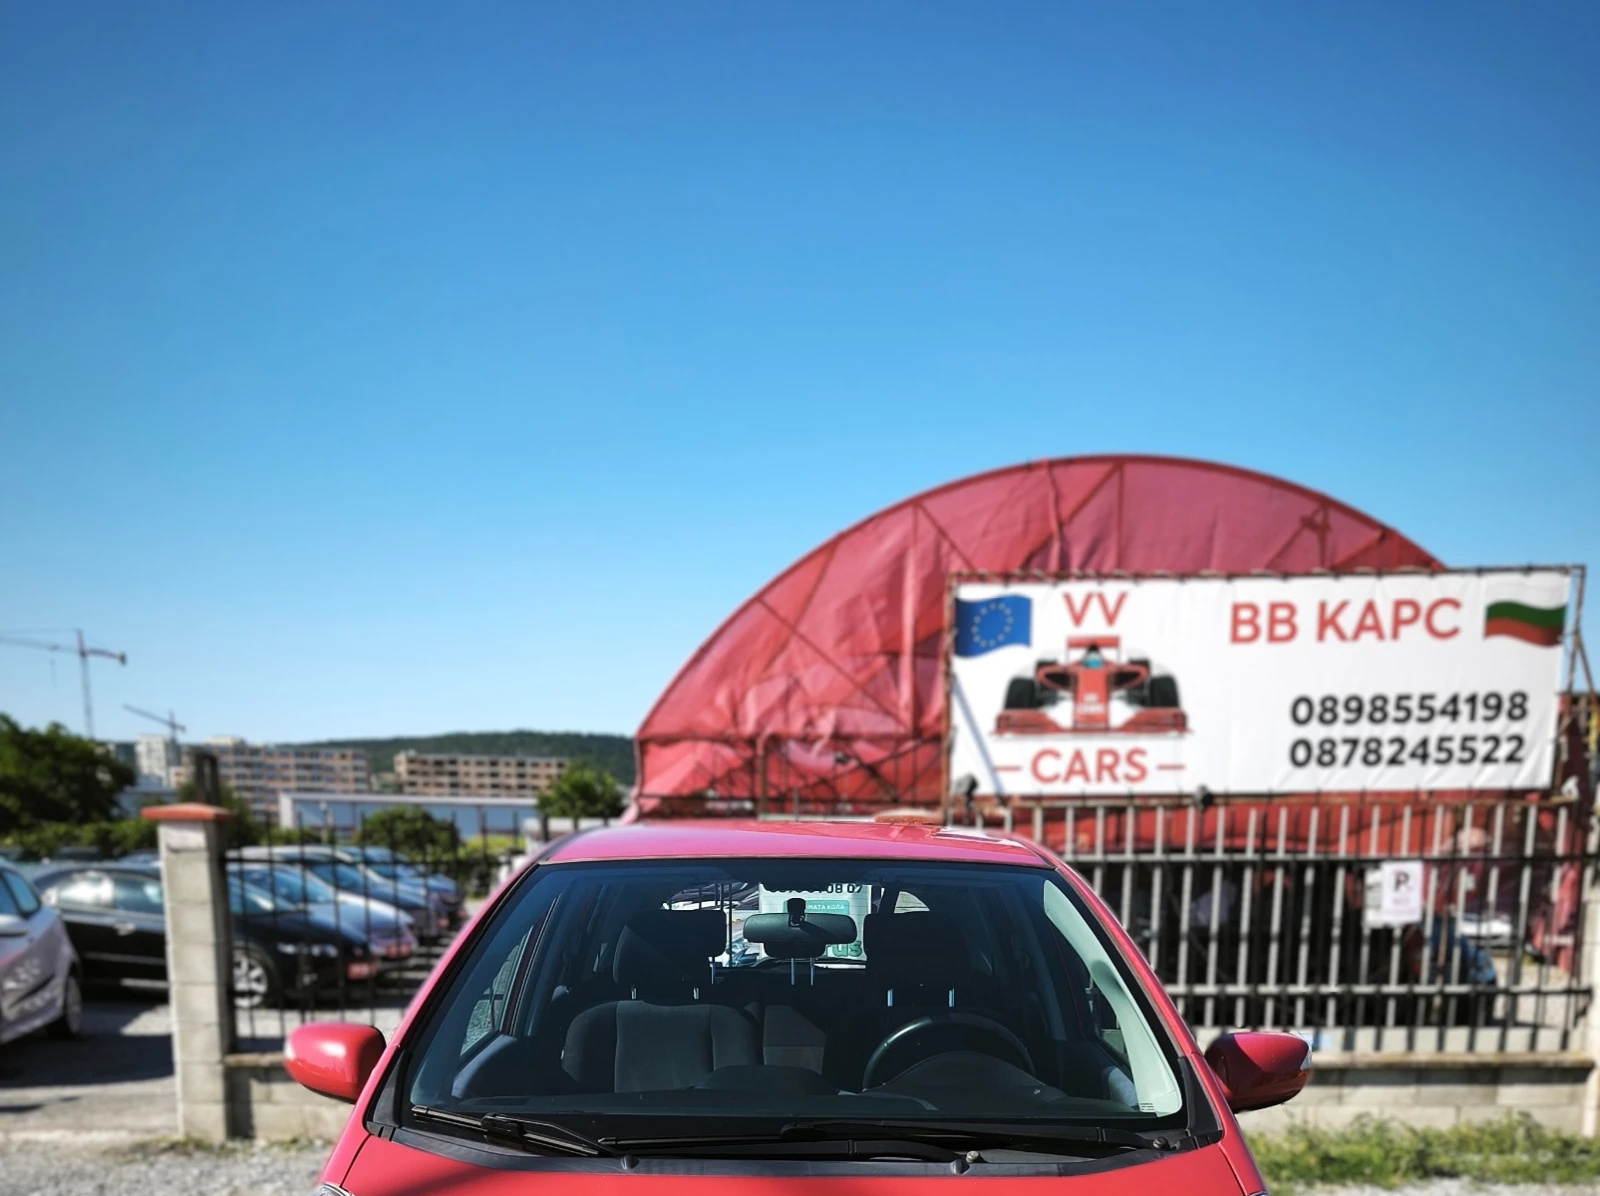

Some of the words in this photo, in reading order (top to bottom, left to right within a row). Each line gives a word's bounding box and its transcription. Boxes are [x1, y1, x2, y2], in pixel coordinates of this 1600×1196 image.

[1062, 592, 1128, 627] VV
[1316, 597, 1462, 642] КАРС
[1291, 692, 1528, 726] 0898554198
[1030, 748, 1148, 785] CARS
[1290, 735, 1525, 768] 0878245522
